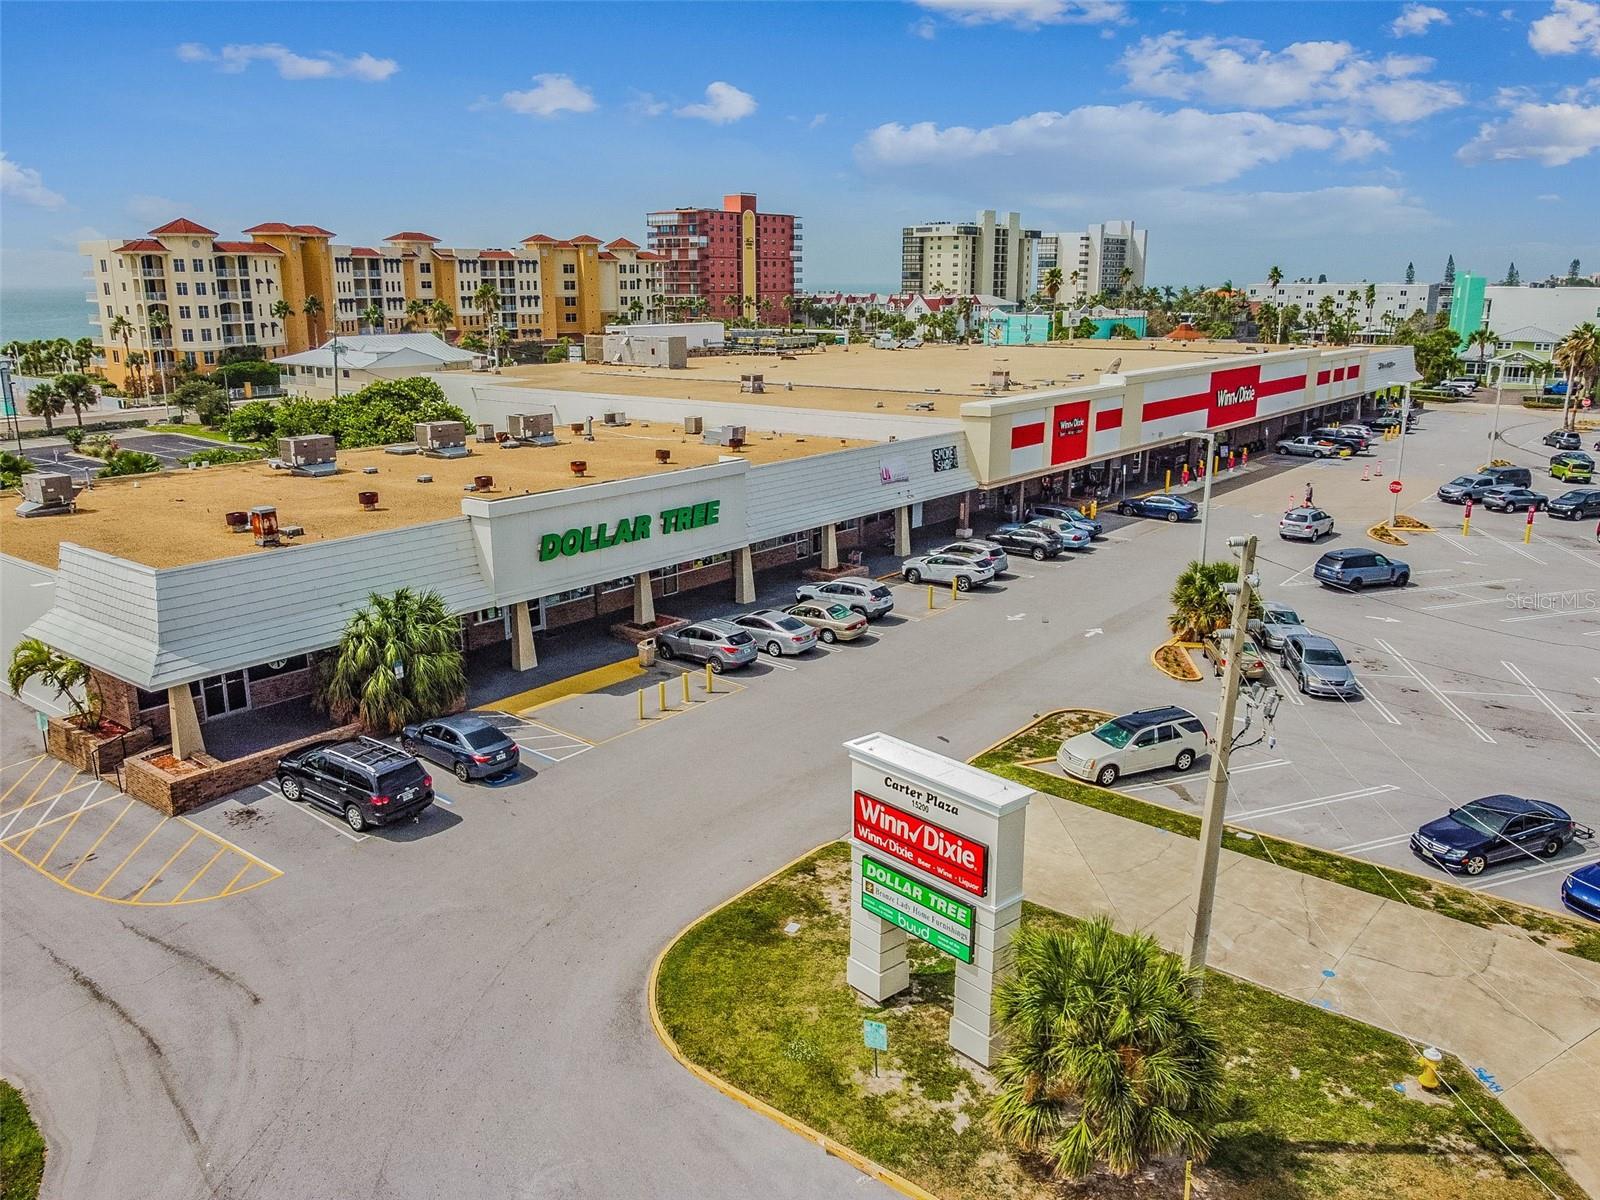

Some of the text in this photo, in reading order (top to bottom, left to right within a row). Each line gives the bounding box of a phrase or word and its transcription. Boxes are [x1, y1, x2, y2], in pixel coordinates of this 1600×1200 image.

[539, 500, 720, 562] DOLLAR TREE
[884, 776, 959, 816] Carter Plaza
[911, 800, 929, 814] 15200
[866, 863, 923, 901] DOLLAR
[928, 893, 967, 923] TREE
[917, 857, 931, 869] Beer
[936, 866, 953, 879] Wine
[958, 876, 980, 891] Liquor
[896, 897, 911, 914] Lady
[912, 905, 930, 921] Home
[931, 915, 968, 942] Furnishings
